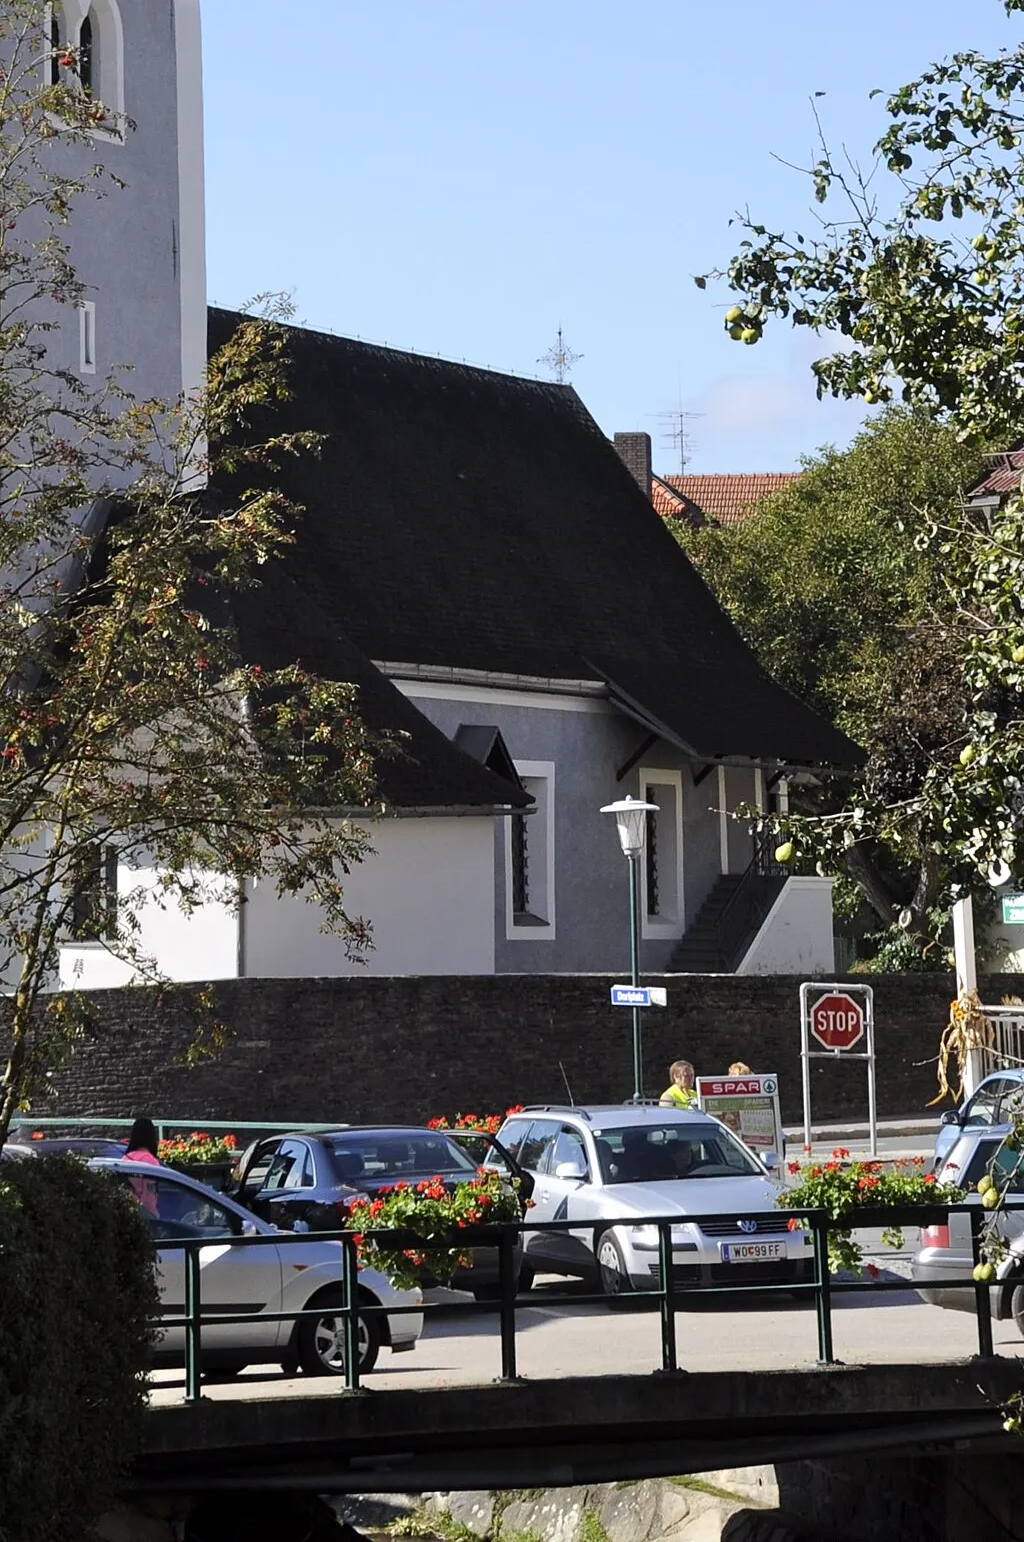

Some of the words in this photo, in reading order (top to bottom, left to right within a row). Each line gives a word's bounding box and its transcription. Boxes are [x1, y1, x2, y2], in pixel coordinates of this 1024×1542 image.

[616, 991, 645, 1003] Dorfplatz
[817, 1010, 857, 1032] STOP
[712, 1082, 759, 1094] SPAR
[733, 1246, 747, 1257] WO
[755, 1245, 767, 1256] 99
[768, 1244, 780, 1256] FF
